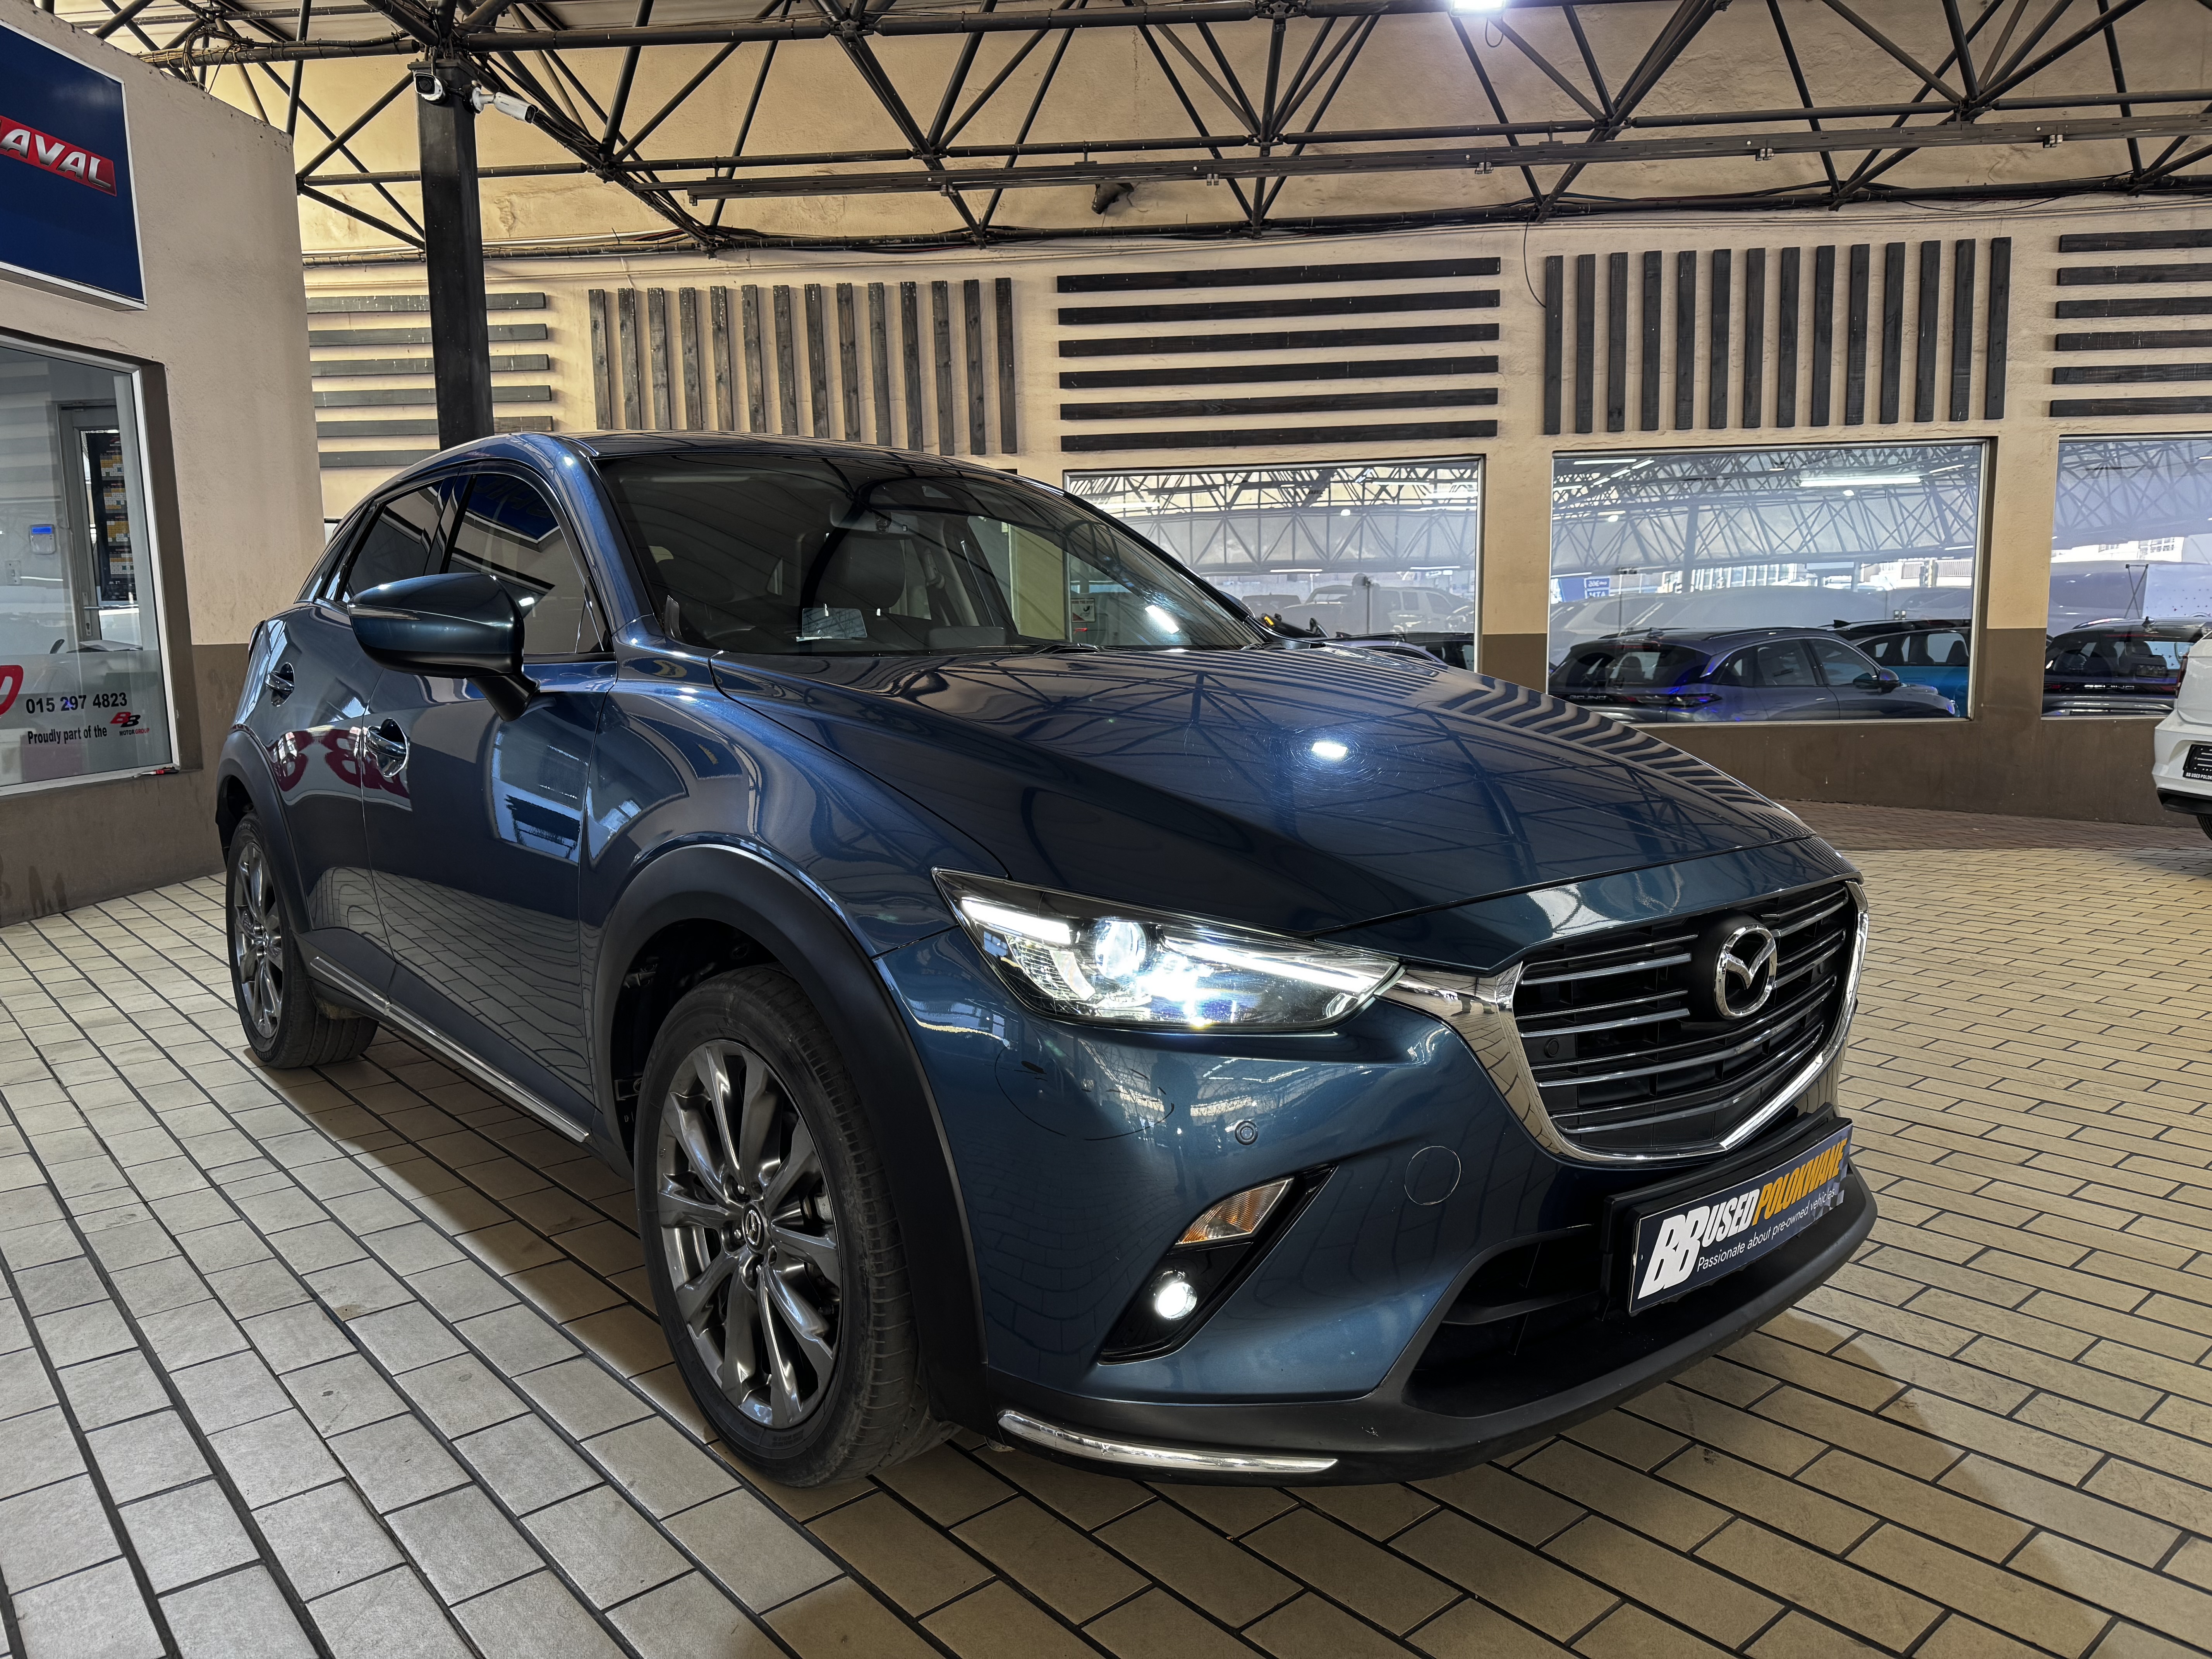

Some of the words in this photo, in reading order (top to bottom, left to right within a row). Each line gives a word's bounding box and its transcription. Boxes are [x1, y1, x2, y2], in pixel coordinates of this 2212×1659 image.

[0, 120, 111, 188] AVAL
[26, 697, 55, 714] 015
[60, 695, 87, 711] 297
[93, 692, 127, 708] 4823
[27, 729, 61, 744] Proudly
[64, 727, 81, 744] part
[83, 725, 91, 738] of
[94, 725, 107, 738] the
[1638, 1206, 1710, 1299] BB
[1702, 1189, 1760, 1247] USED
[1752, 1137, 1848, 1226] POLOKWANE
[1697, 1242, 1745, 1272] Passionate
[1747, 1227, 1772, 1249] about
[1772, 1205, 1809, 1236] pre-owned
[1810, 1188, 1835, 1211] vehicles
